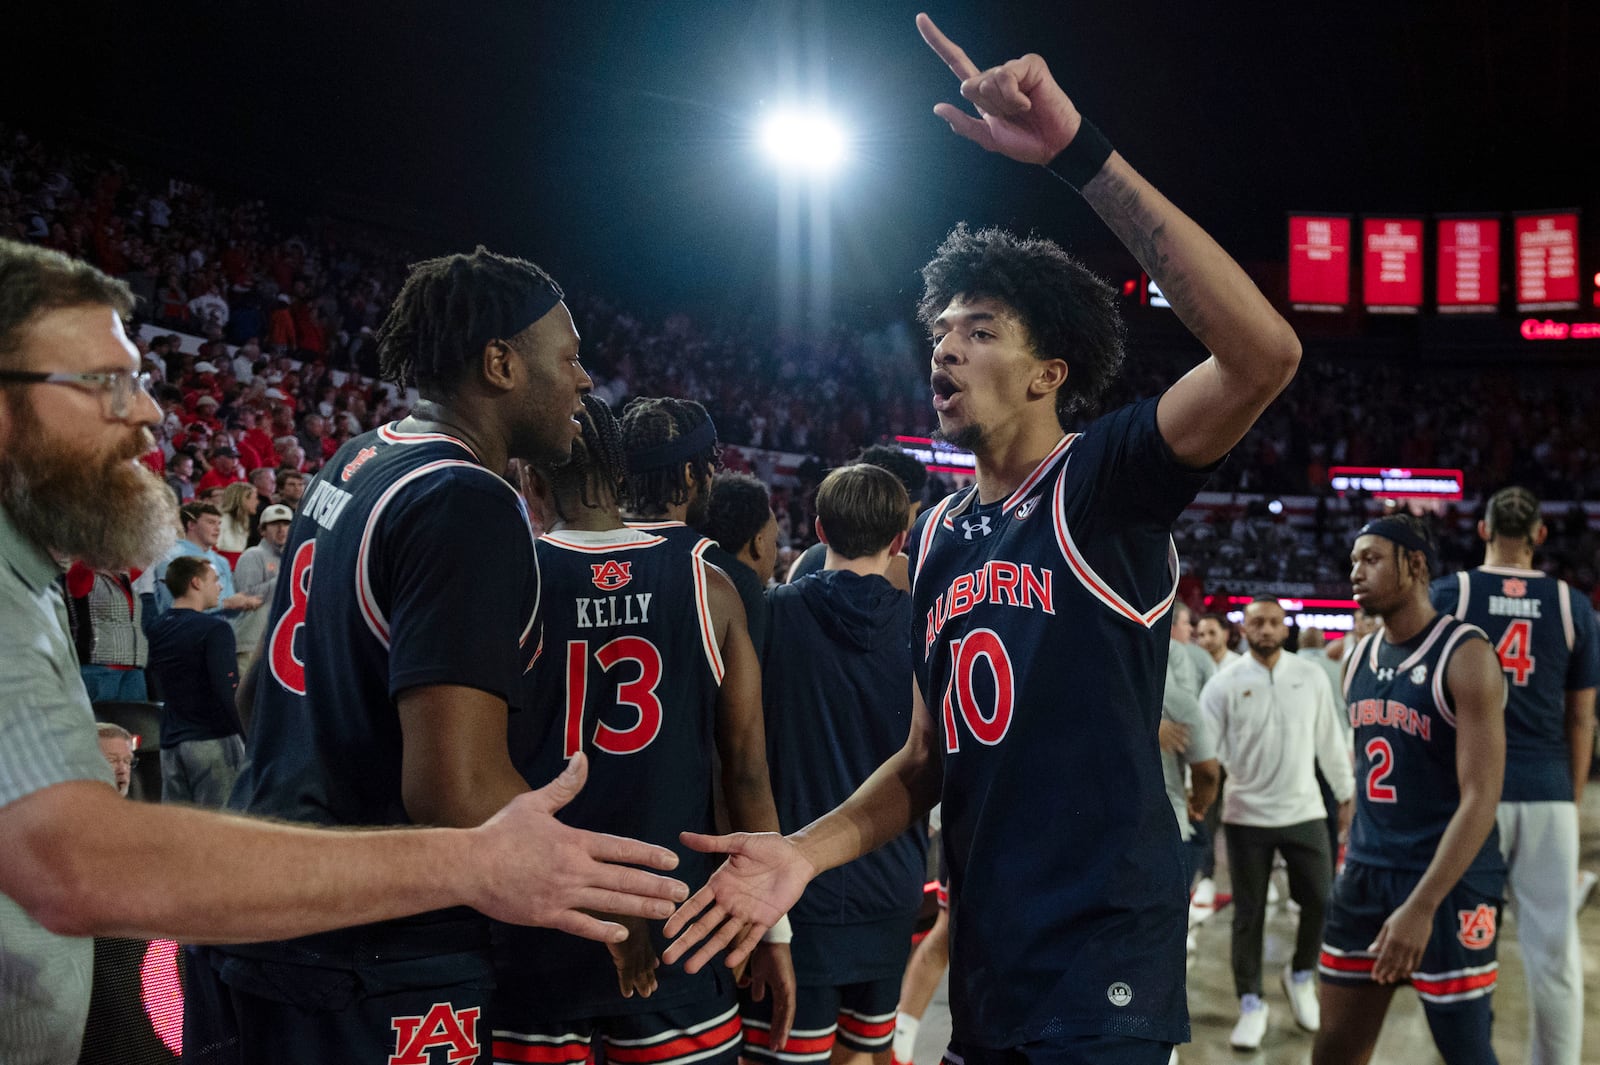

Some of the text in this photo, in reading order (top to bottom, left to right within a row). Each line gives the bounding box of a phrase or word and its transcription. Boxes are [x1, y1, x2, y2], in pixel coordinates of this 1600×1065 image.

[576, 593, 652, 628] KELLY
[924, 560, 1055, 663] AUBURN
[1495, 619, 1536, 687] 4
[564, 635, 663, 760] 13
[943, 627, 1015, 754] 10
[1349, 698, 1432, 741] UBURN
[1365, 737, 1397, 803] 2
